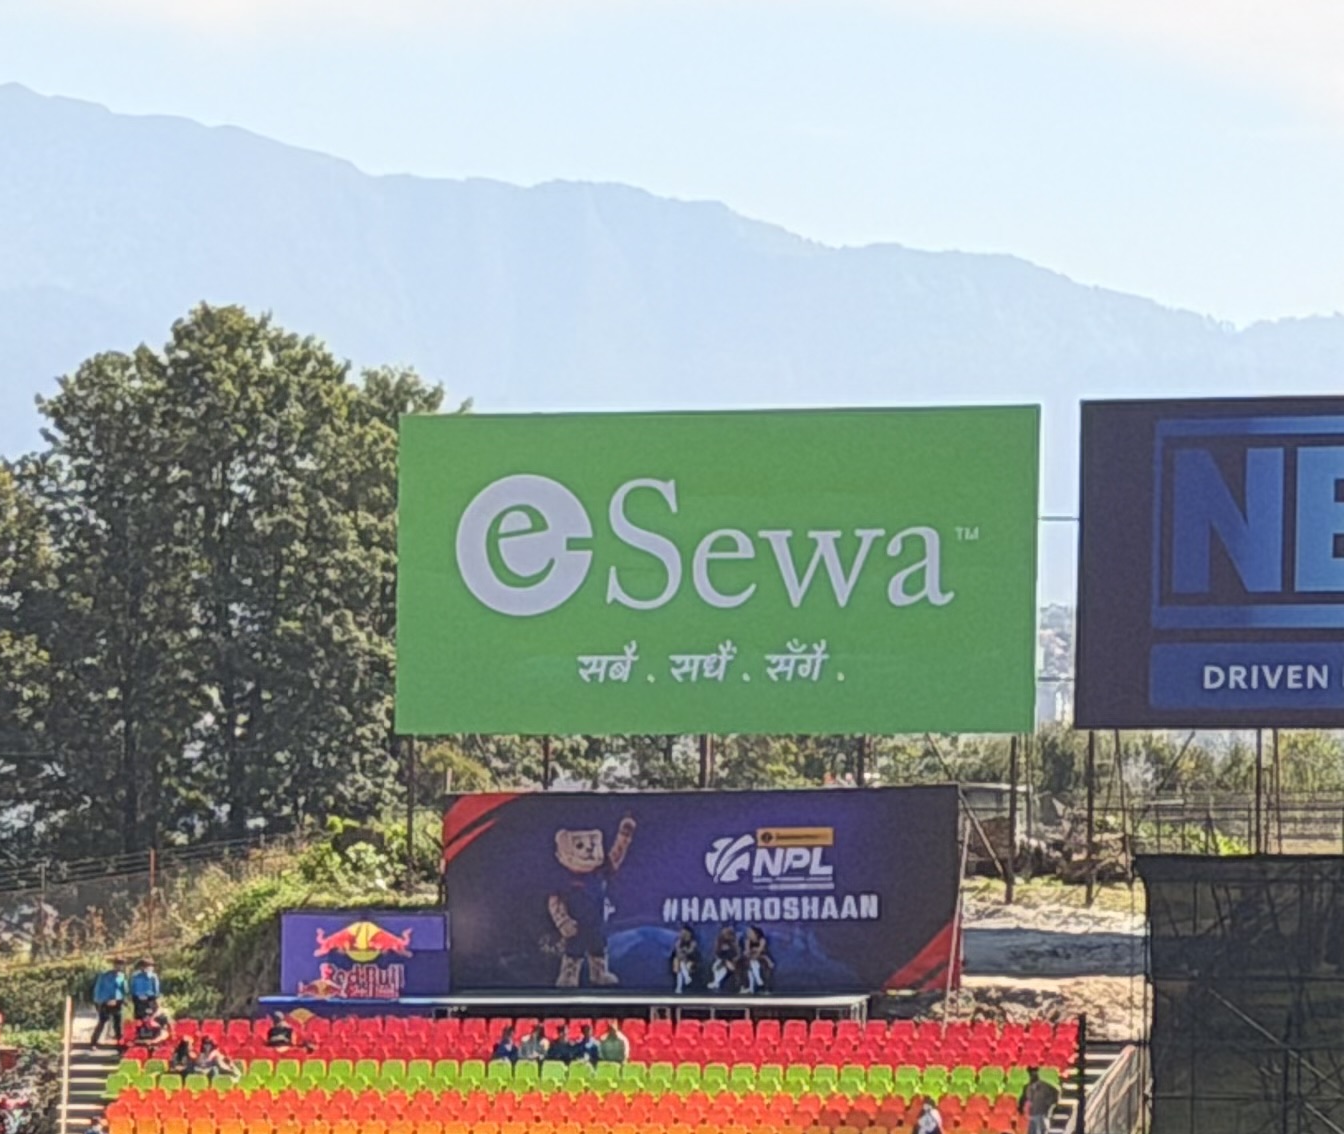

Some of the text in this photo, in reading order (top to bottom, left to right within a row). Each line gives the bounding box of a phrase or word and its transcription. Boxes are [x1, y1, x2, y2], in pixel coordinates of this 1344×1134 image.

[1203, 665, 1329, 689] DRIVEN
[752, 847, 833, 876] NPL
[663, 894, 879, 922] #HAMROSHAAN
